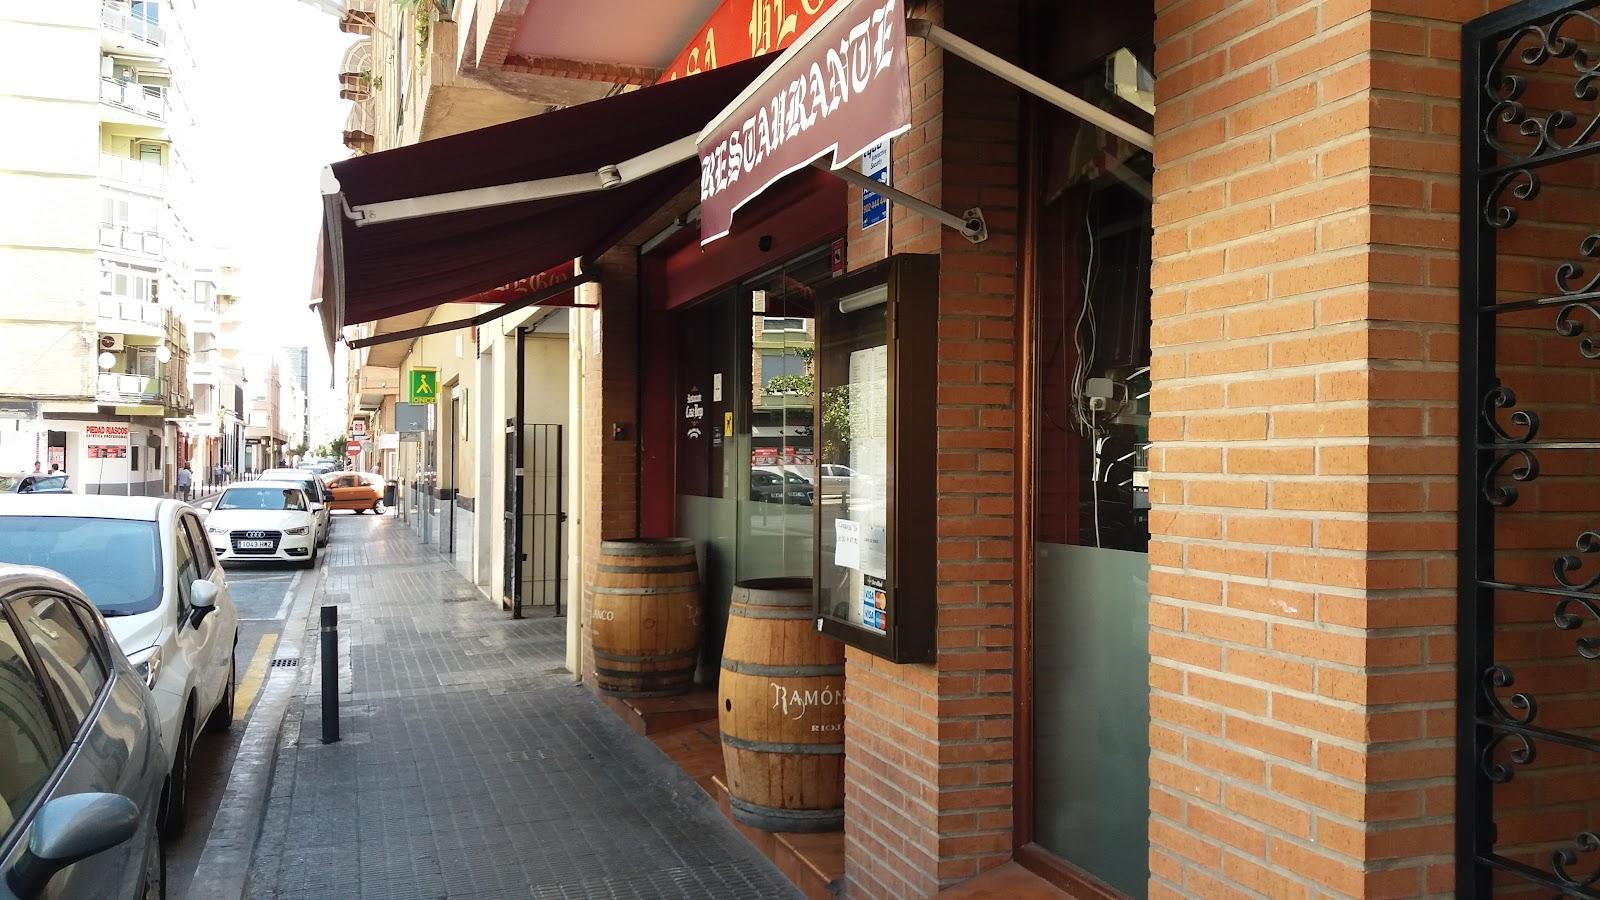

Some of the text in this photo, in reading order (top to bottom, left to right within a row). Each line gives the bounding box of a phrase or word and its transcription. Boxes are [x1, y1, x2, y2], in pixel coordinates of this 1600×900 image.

[701, 0, 896, 200] RESTAURANTE
[86, 426, 127, 435] PIEDAD RIASCOS
[865, 590, 874, 599] VISA
[865, 610, 874, 620] VISA
[771, 682, 845, 720] RAMÓN
[811, 724, 845, 732] RIOJ
